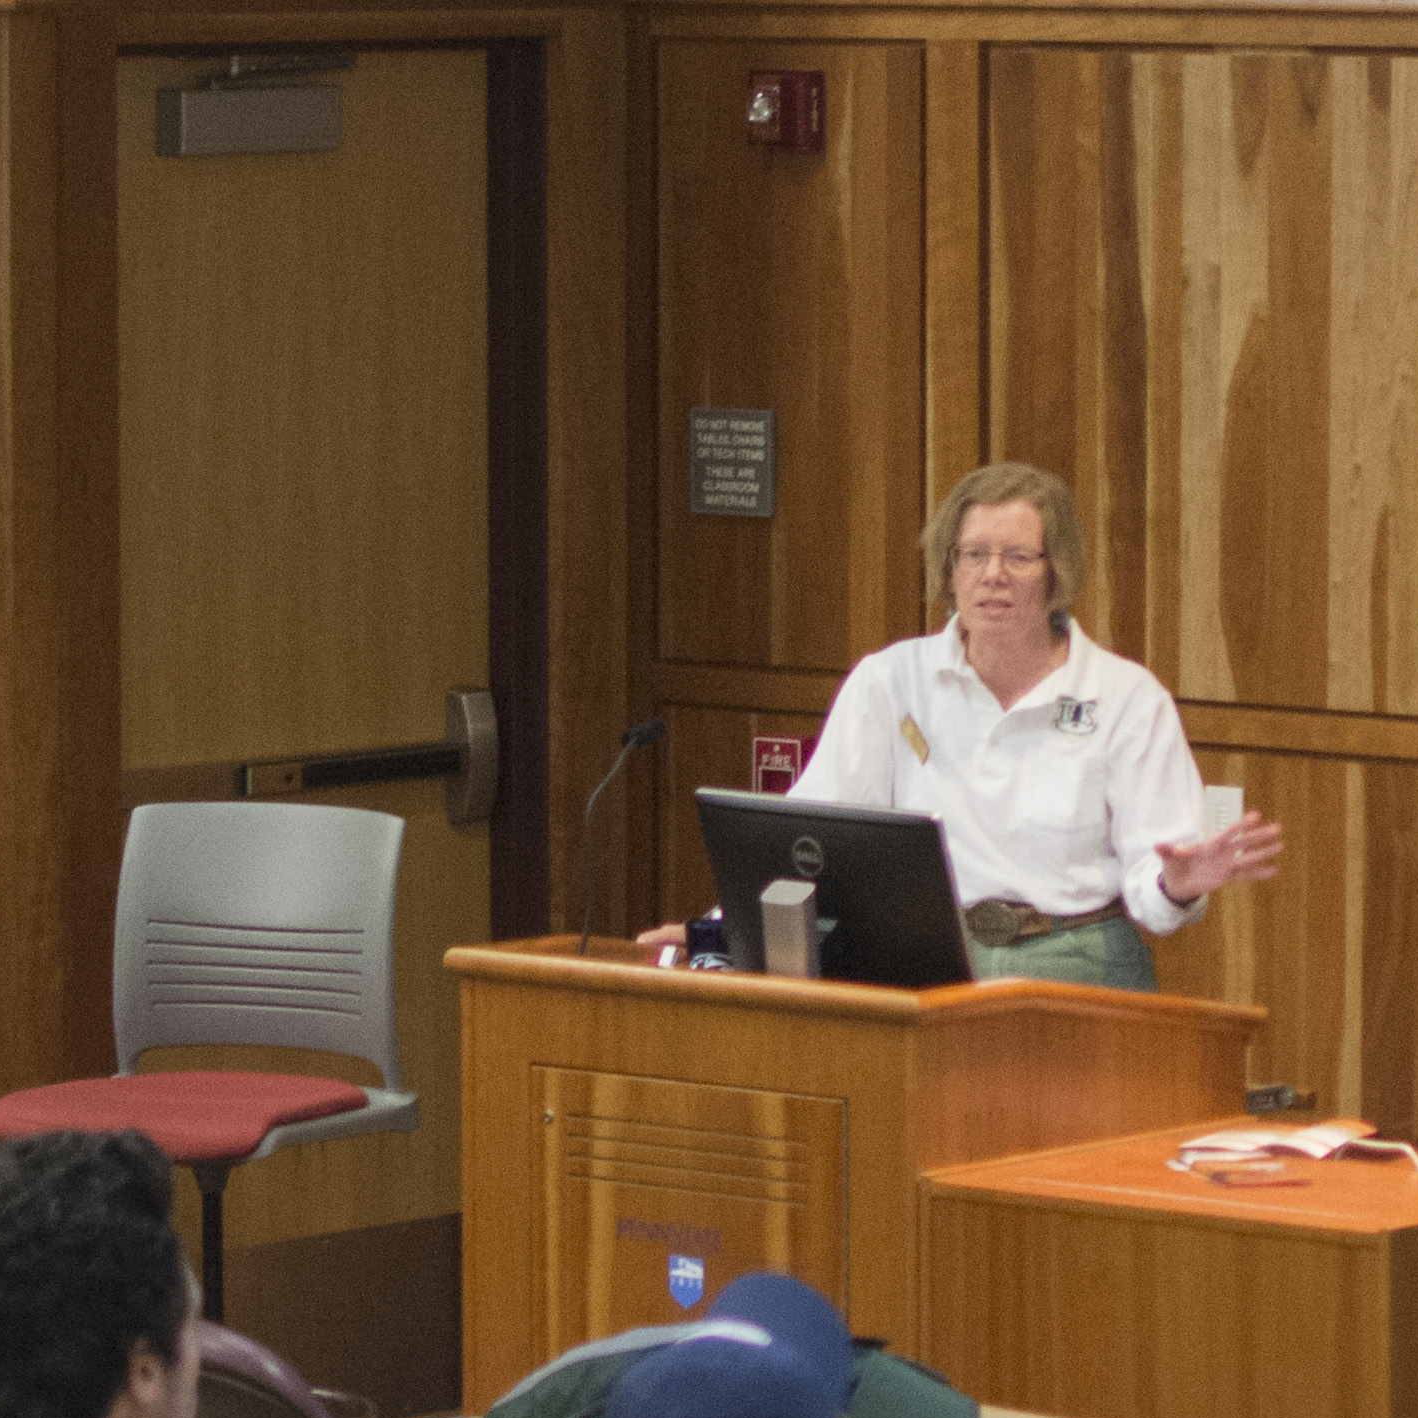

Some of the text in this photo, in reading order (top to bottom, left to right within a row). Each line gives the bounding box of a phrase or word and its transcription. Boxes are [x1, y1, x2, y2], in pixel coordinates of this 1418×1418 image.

[695, 419, 765, 431] DO NOT REMOVE
[696, 447, 710, 458] OR
[737, 449, 765, 461] ITEMS
[705, 466, 756, 479] THESE ARE
[702, 480, 760, 493] CLASSROOM
[704, 494, 757, 508] MATERIALS
[761, 753, 791, 768] FIRE
